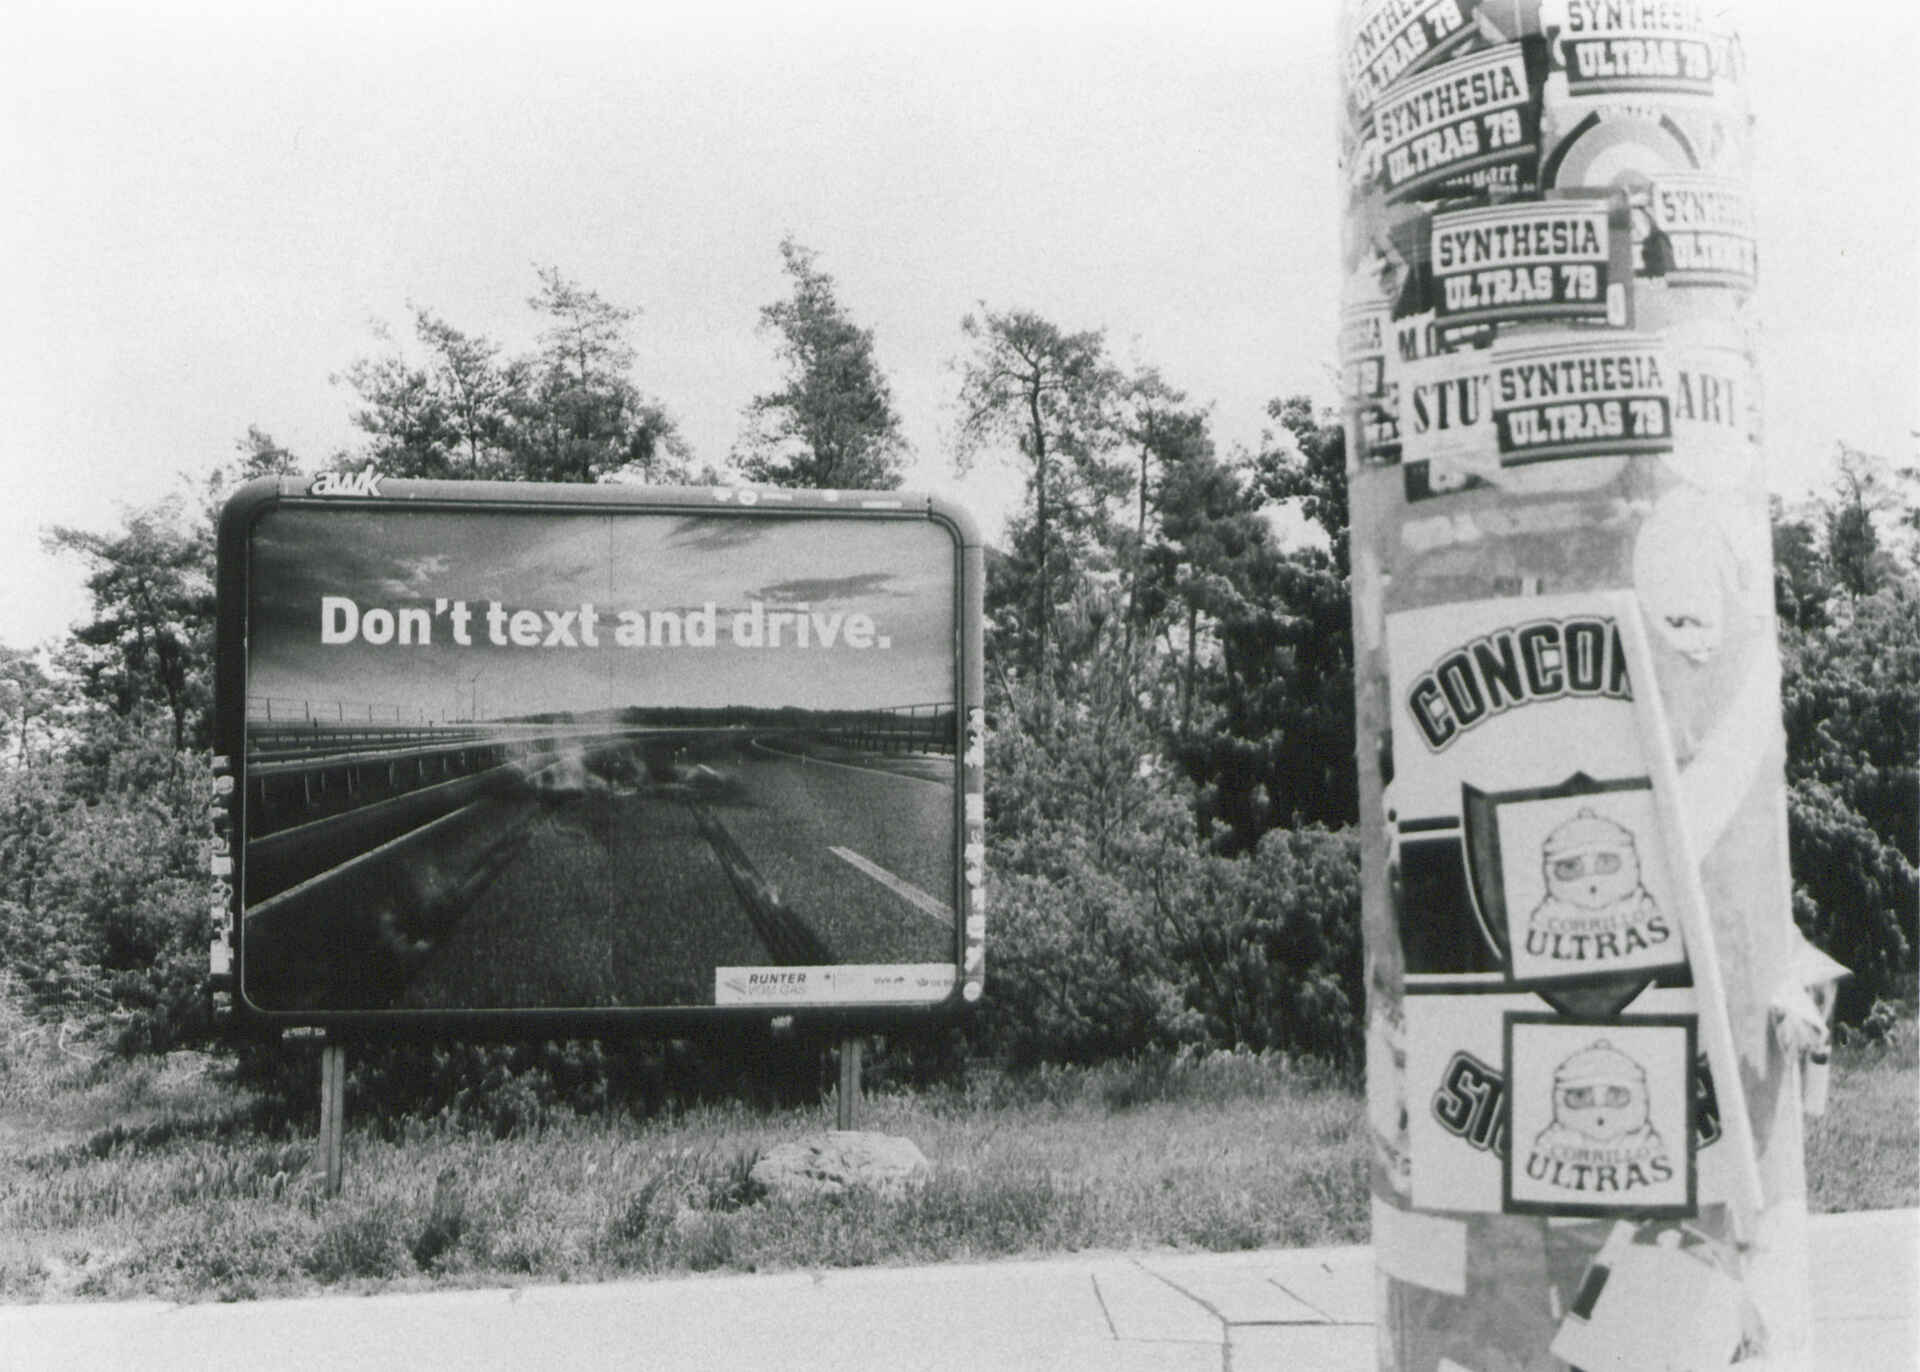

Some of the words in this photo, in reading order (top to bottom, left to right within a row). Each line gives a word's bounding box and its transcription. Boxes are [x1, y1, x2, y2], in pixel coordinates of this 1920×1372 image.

[1356, 22, 1429, 110] ULTRAS
[1425, 0, 1463, 39] 79
[1577, 40, 1678, 77] ULTRAS
[1380, 66, 1521, 144] SYNTHESIA
[1388, 120, 1481, 184] ULTRAS
[1484, 108, 1523, 147] 79
[1439, 220, 1602, 268] SYNTHESIA
[1444, 265, 1555, 309] ULTRAS
[1560, 264, 1598, 300] 79
[1500, 355, 1664, 402] SYNTHESIA
[1508, 401, 1624, 446] ULTRAS
[1629, 400, 1665, 436] 79
[320, 595, 472, 646] Don't
[486, 600, 599, 647] text
[615, 600, 716, 648] and
[731, 599, 893, 650] drive.
[1525, 914, 1672, 961] ULTRAS
[748, 972, 807, 985] RUNTER
[1525, 1150, 1675, 1193] ULTRAS
